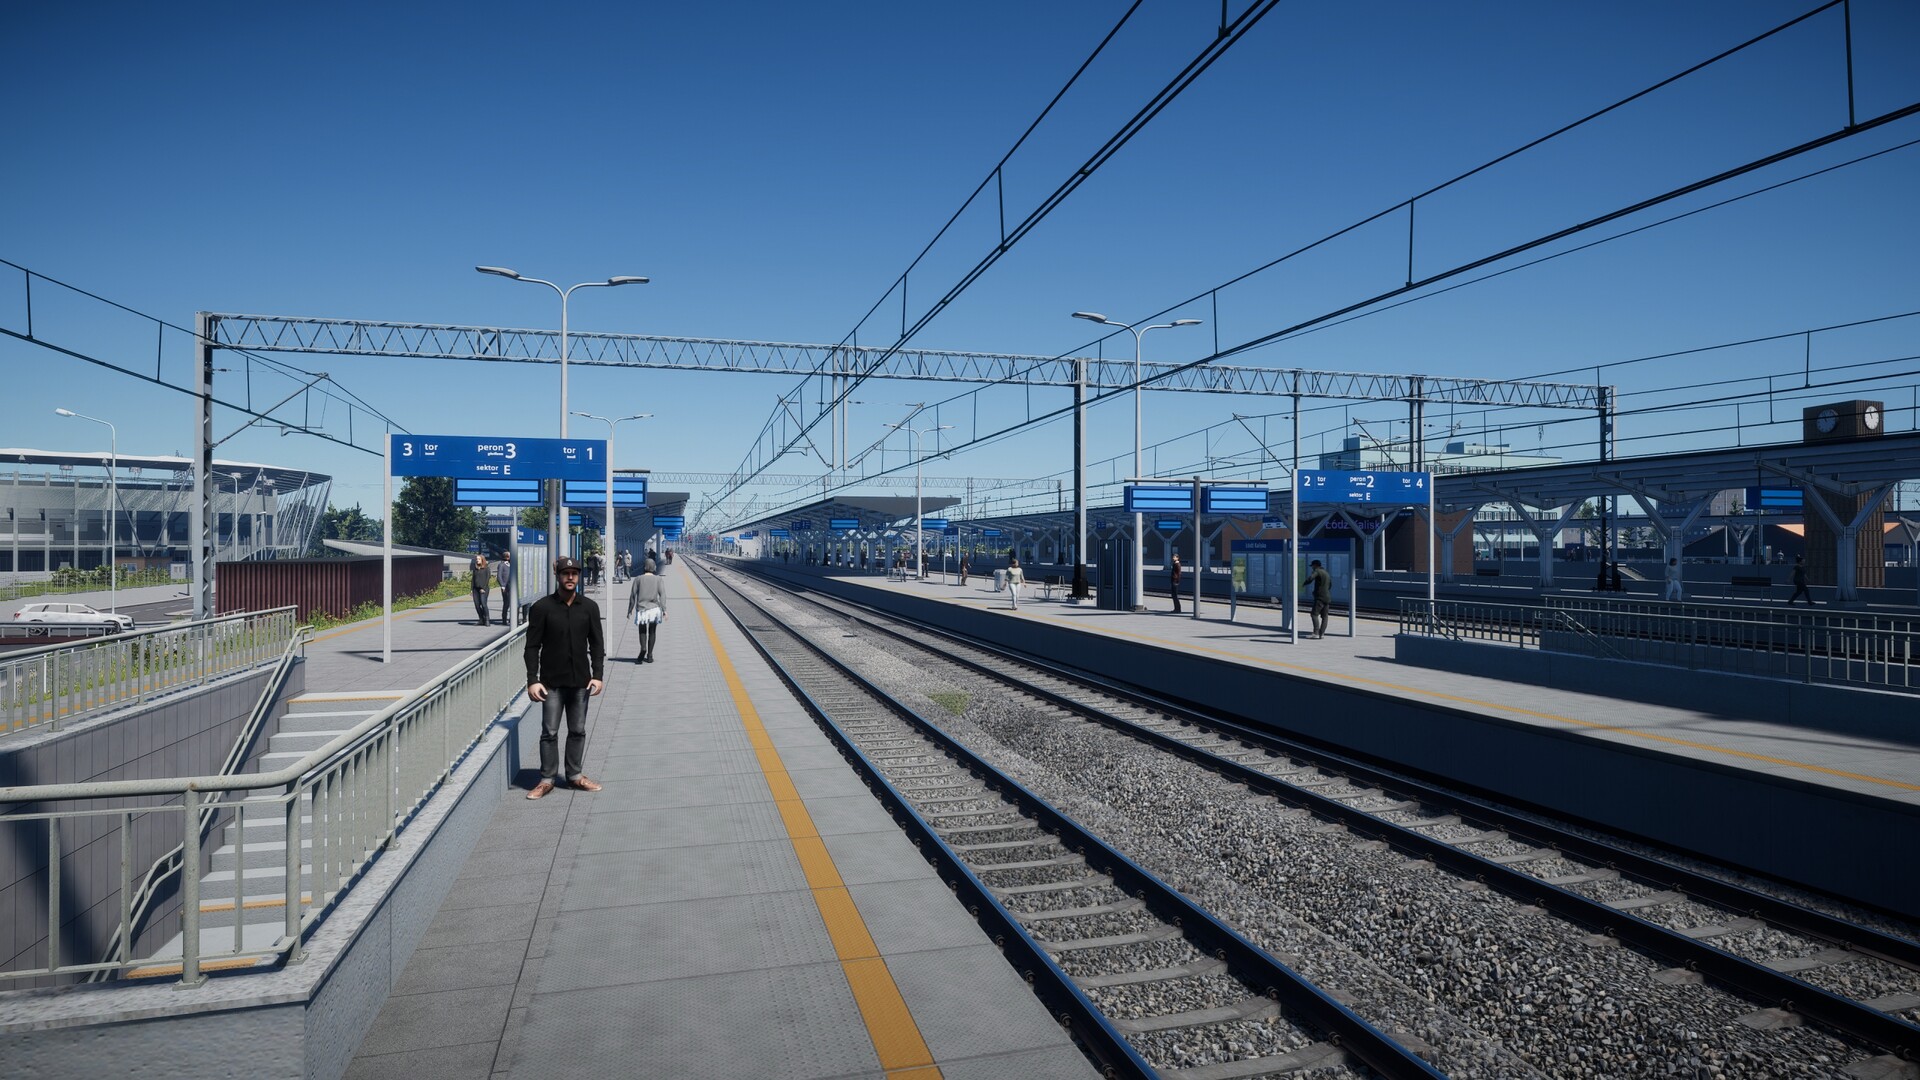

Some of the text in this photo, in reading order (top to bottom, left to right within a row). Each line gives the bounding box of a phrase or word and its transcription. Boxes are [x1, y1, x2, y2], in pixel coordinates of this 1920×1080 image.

[403, 443, 438, 456] 3 tor
[478, 444, 503, 452] peron
[505, 443, 516, 459] 3
[587, 448, 593, 460] 1
[503, 465, 511, 475] E
[1304, 475, 1311, 487] 2
[1366, 475, 1374, 488] 2
[1416, 478, 1423, 488] 4
[1366, 492, 1371, 501] E
